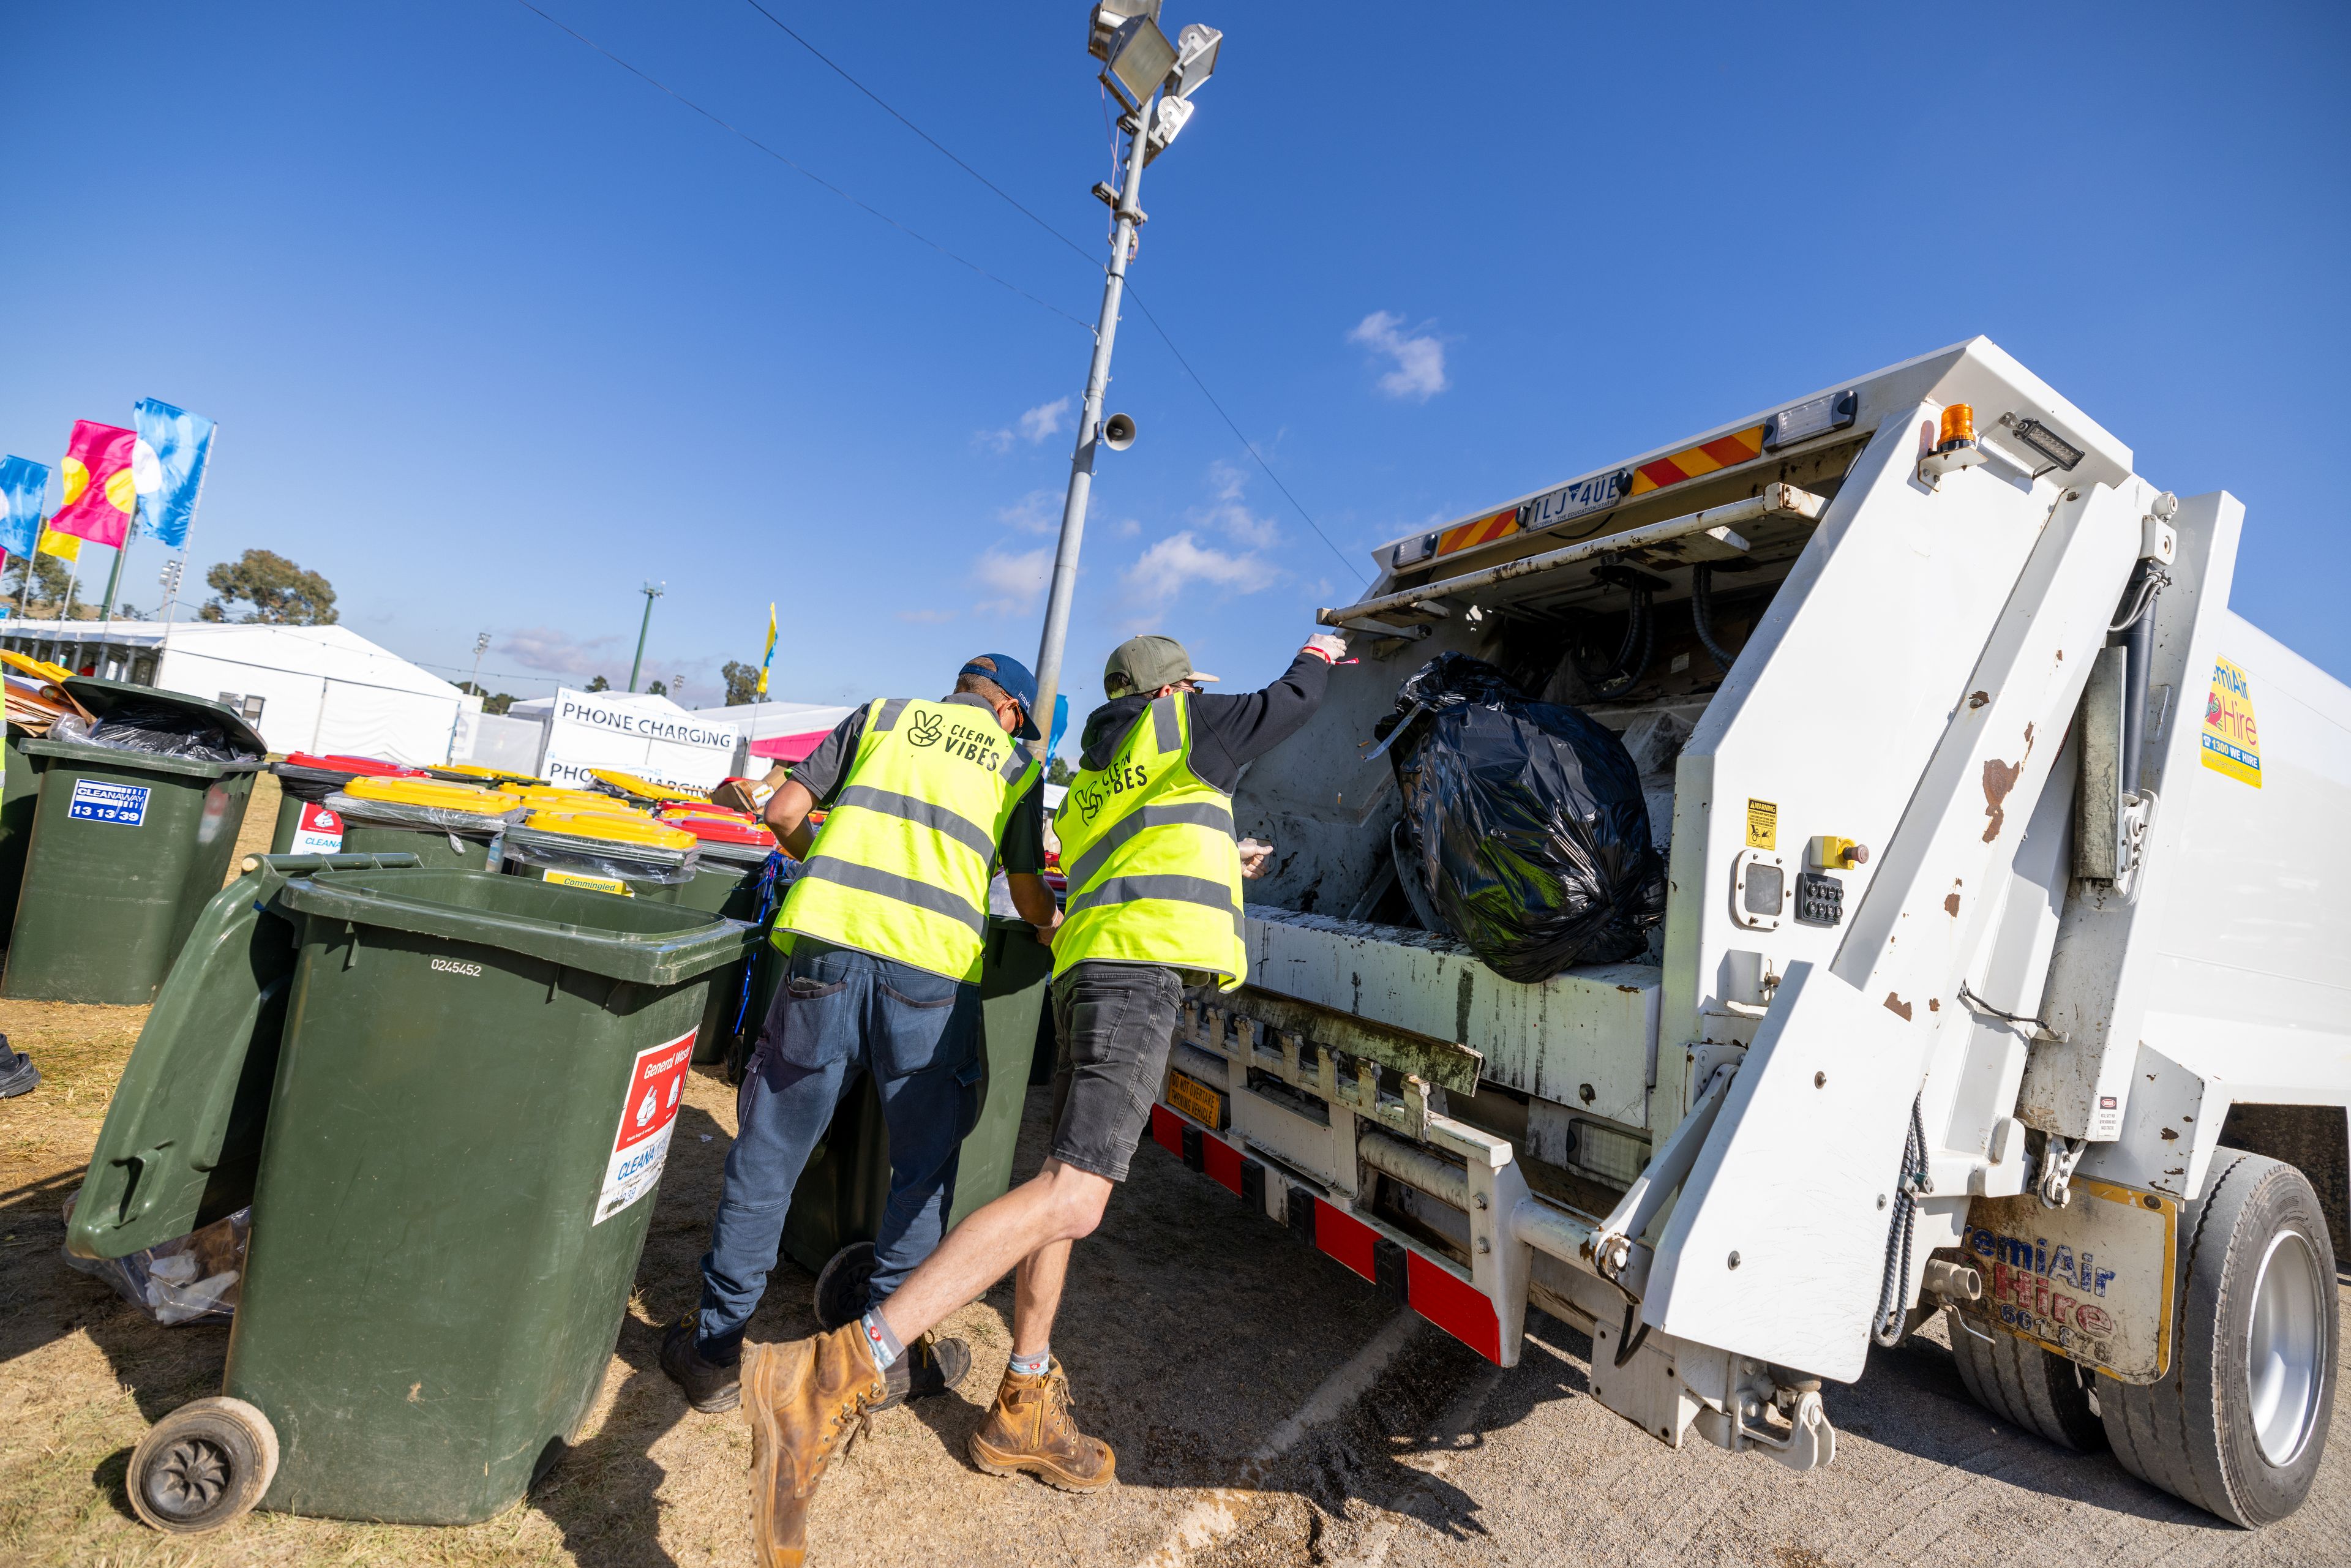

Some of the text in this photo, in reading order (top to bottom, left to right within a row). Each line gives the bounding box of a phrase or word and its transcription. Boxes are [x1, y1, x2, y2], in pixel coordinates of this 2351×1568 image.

[1534, 476, 1617, 522] 1LJ 4UE
[1531, 519, 1553, 529] VICTORIA
[1567, 506, 1596, 519] EDUCATION
[1598, 500, 1614, 509] STATE
[563, 702, 730, 748] PHONE CHARGING
[2222, 695, 2257, 746] Hire
[950, 724, 995, 747] CLEAN
[945, 737, 1000, 771] VIBES
[2211, 739, 2258, 768] 1300 WE HIRE
[550, 763, 593, 782] PHO
[77, 788, 144, 802] CLEANAWAY
[1755, 802, 1775, 812] WARNING
[73, 805, 139, 821] 13 13 39
[305, 838, 342, 847] CLEANA
[564, 878, 615, 891] Commingled
[431, 959, 482, 977] 0245452
[644, 1045, 691, 1079] General Waste
[1172, 1074, 1215, 1108] DO NOT OVERTAKE
[1171, 1089, 1212, 1124] TURNING VEHICLE
[1995, 1262, 2112, 1337] Hire
[2001, 1304, 2047, 1338] 661
[2060, 1326, 2112, 1363] 878
